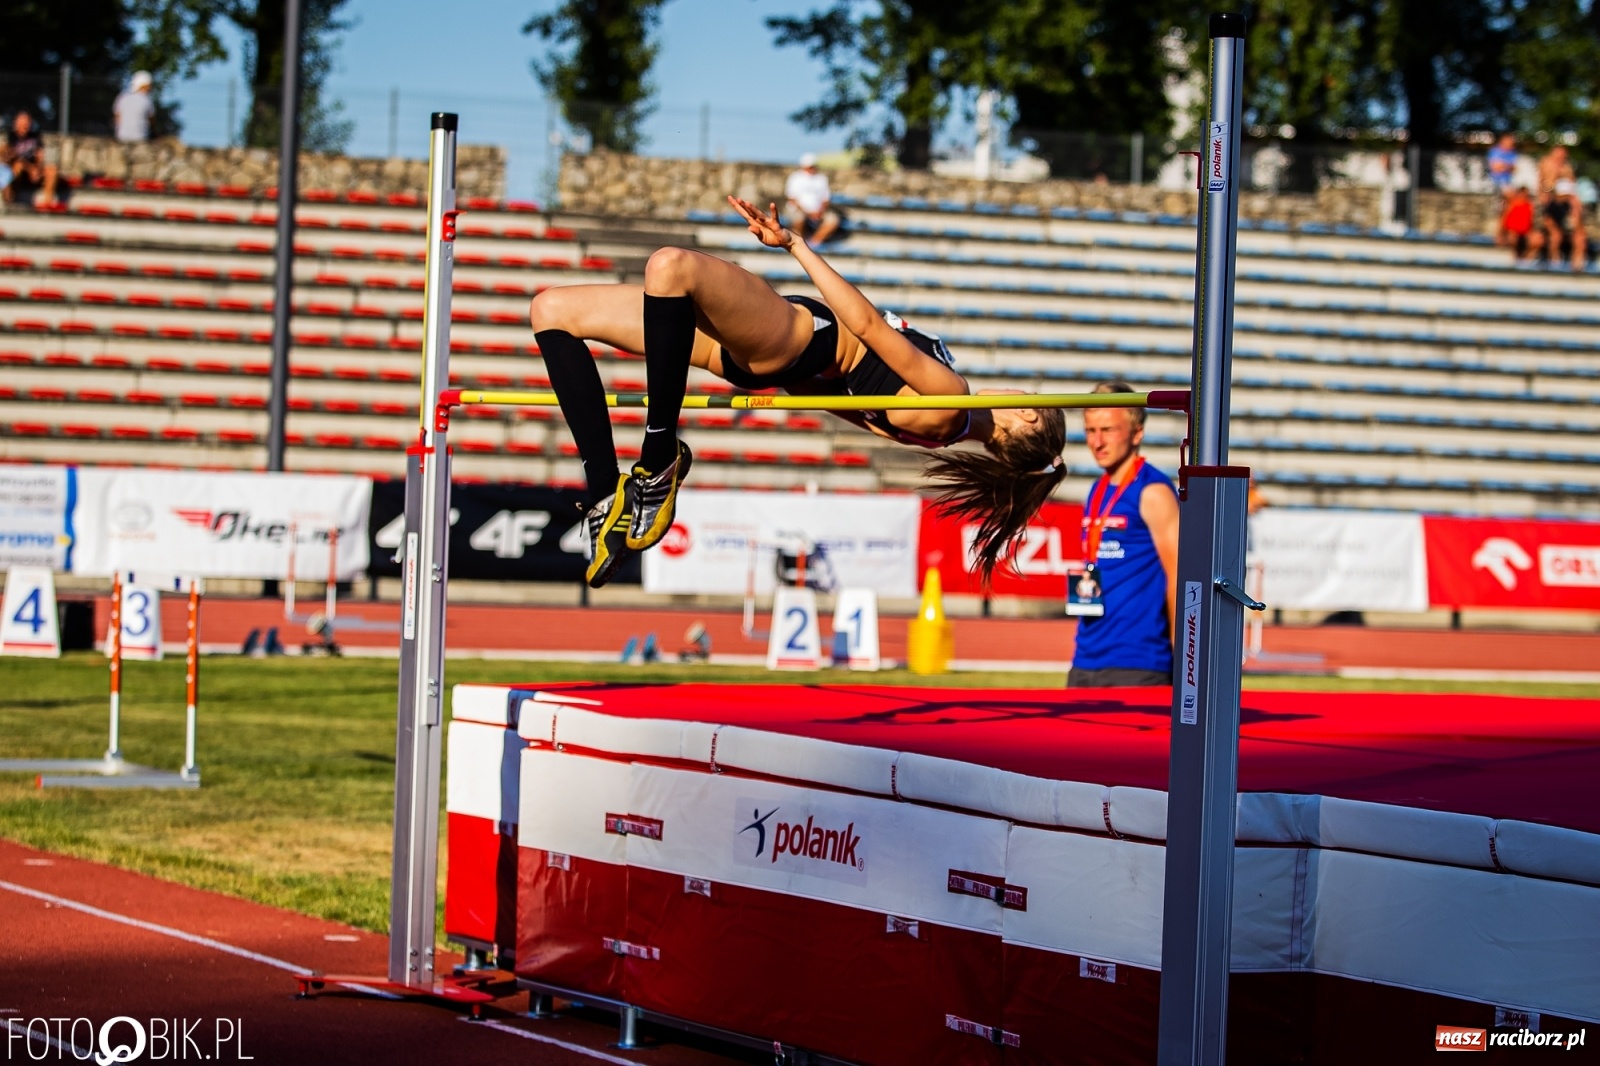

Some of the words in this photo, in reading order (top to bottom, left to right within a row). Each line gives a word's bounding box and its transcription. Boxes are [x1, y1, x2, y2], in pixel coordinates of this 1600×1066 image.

[1212, 139, 1223, 178] polanik
[470, 509, 550, 559] 4F
[12, 587, 46, 634] 4
[124, 591, 150, 636] 3
[785, 607, 809, 650] 2
[848, 608, 864, 648] 1
[1186, 612, 1197, 687] polanik
[772, 815, 861, 867] polanik
